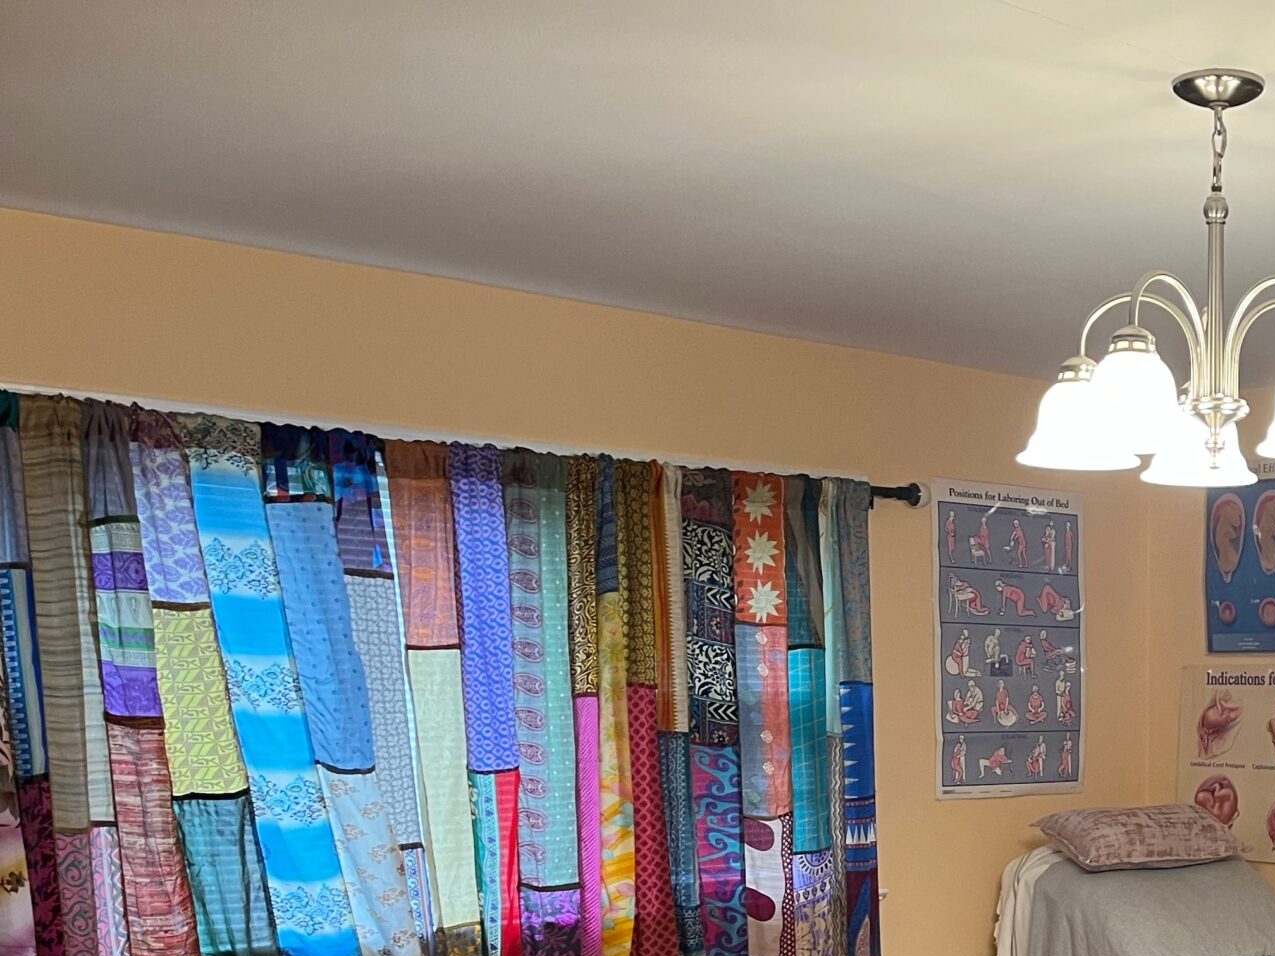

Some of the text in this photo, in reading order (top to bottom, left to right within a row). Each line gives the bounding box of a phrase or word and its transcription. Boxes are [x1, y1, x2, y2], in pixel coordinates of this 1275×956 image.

[949, 488, 1069, 508] Positions for Laboring Out of Bed
[1206, 672, 1266, 686] Indications
